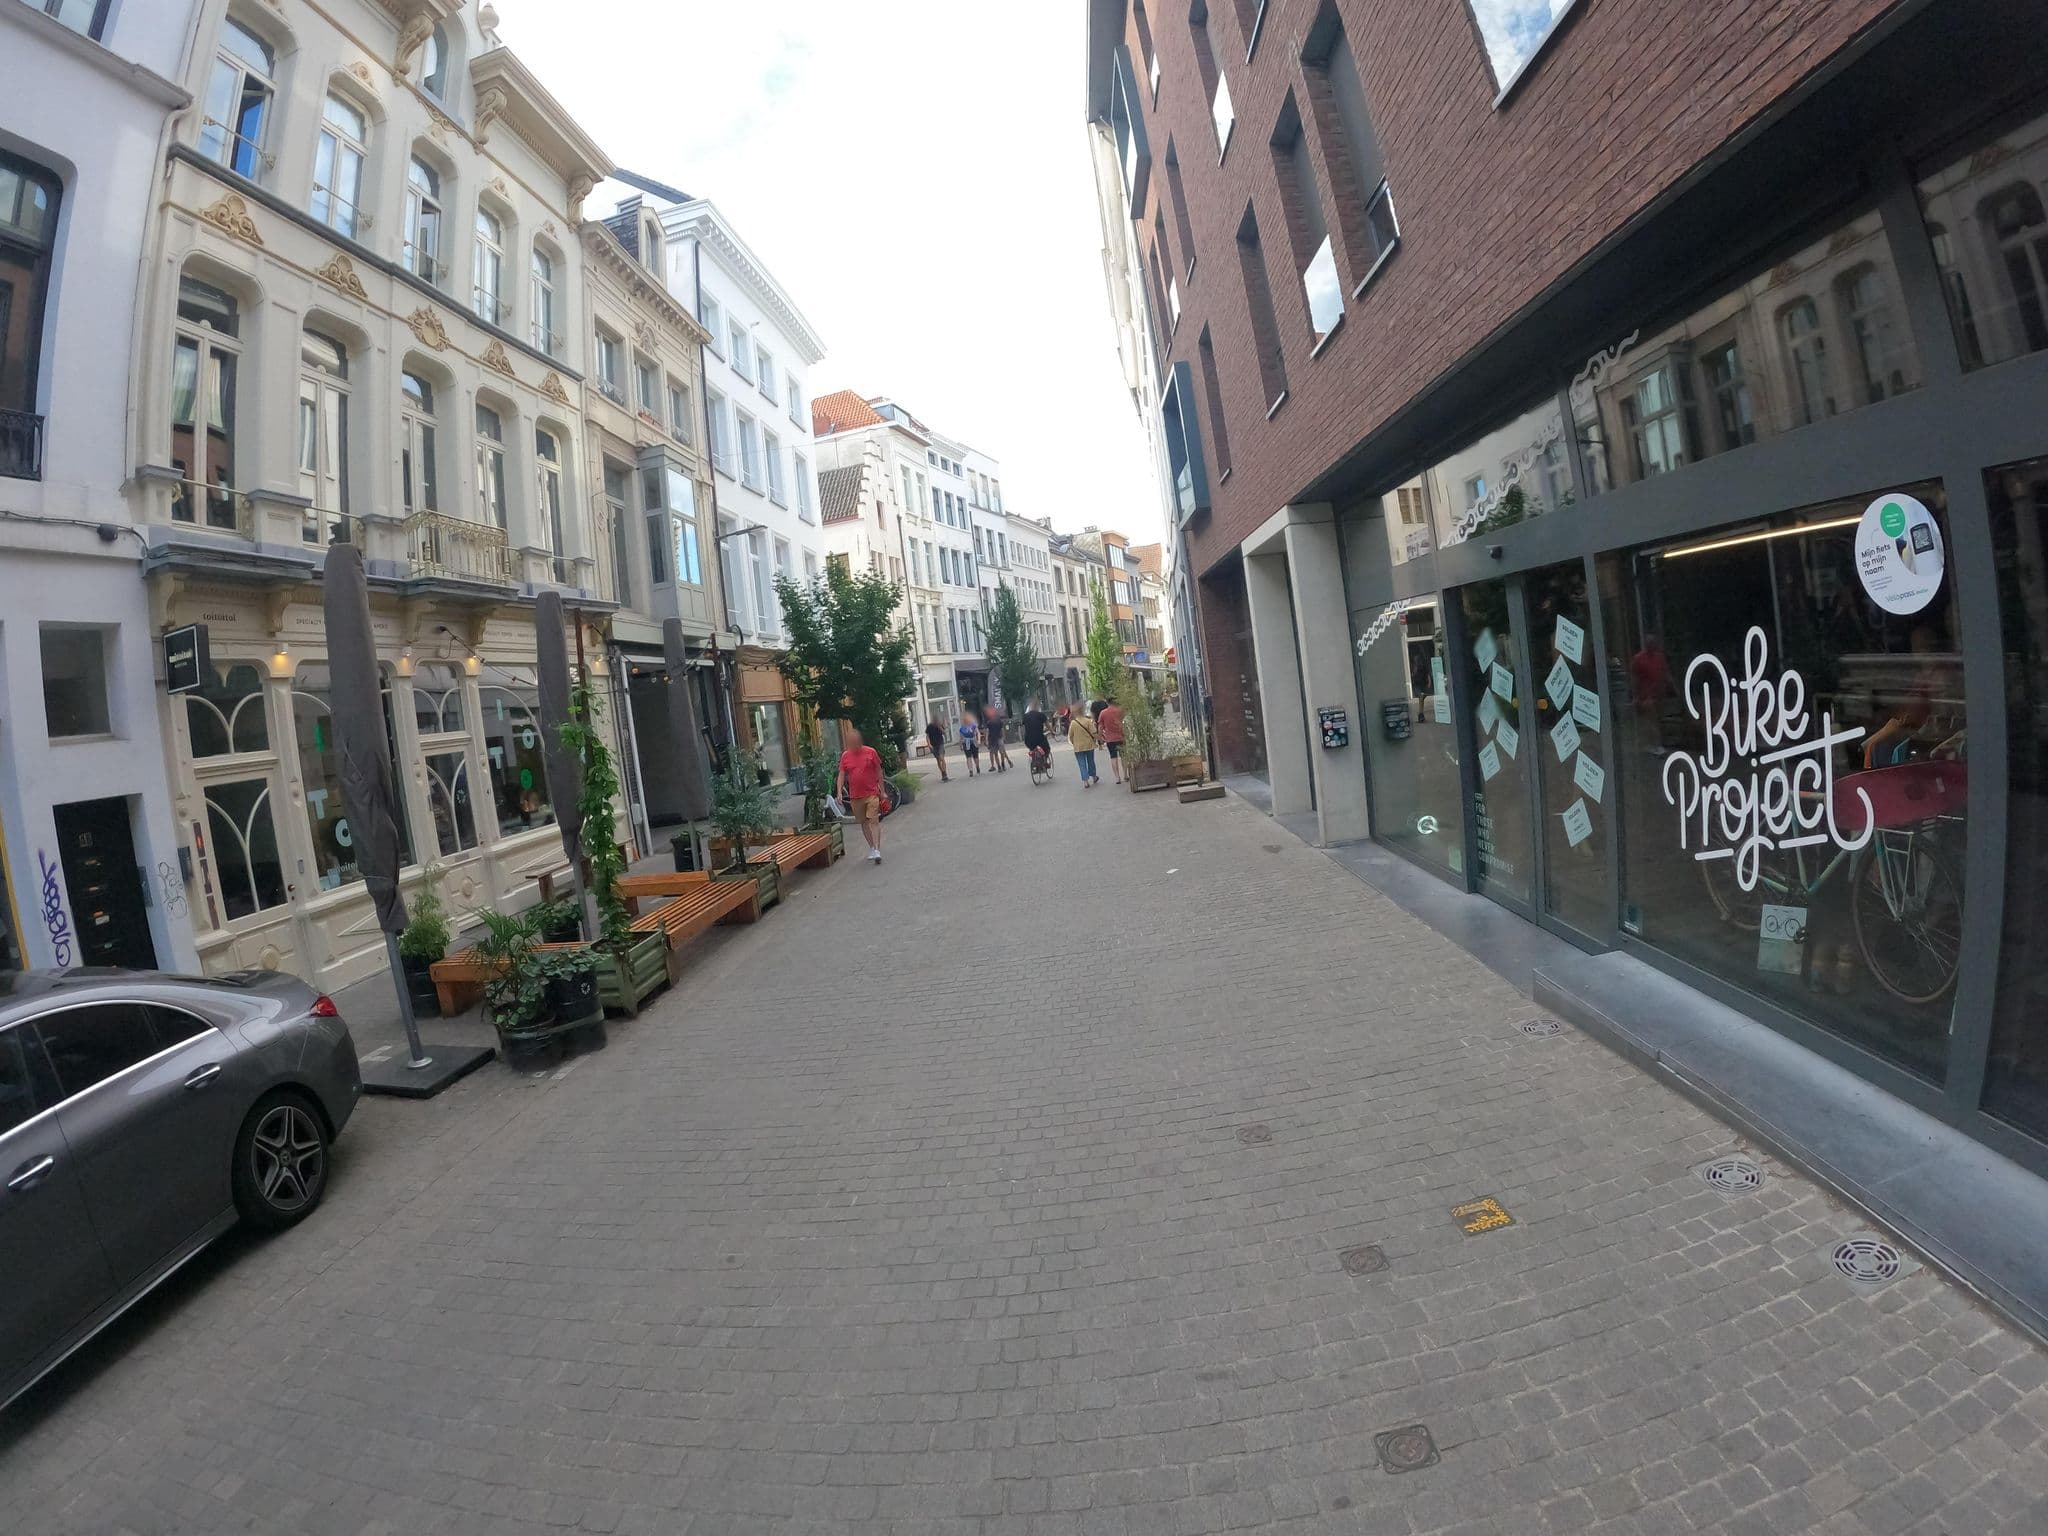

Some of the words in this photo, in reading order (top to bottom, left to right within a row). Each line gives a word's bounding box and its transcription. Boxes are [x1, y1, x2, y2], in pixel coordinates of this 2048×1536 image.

[1861, 548, 1876, 559] Mijn
[1876, 544, 1891, 553] fiets
[1862, 560, 1871, 568] op
[1871, 554, 1886, 565] mijn
[1865, 566, 1884, 576] naam
[1685, 625, 1810, 778] Bike
[1663, 711, 1874, 891] Project
